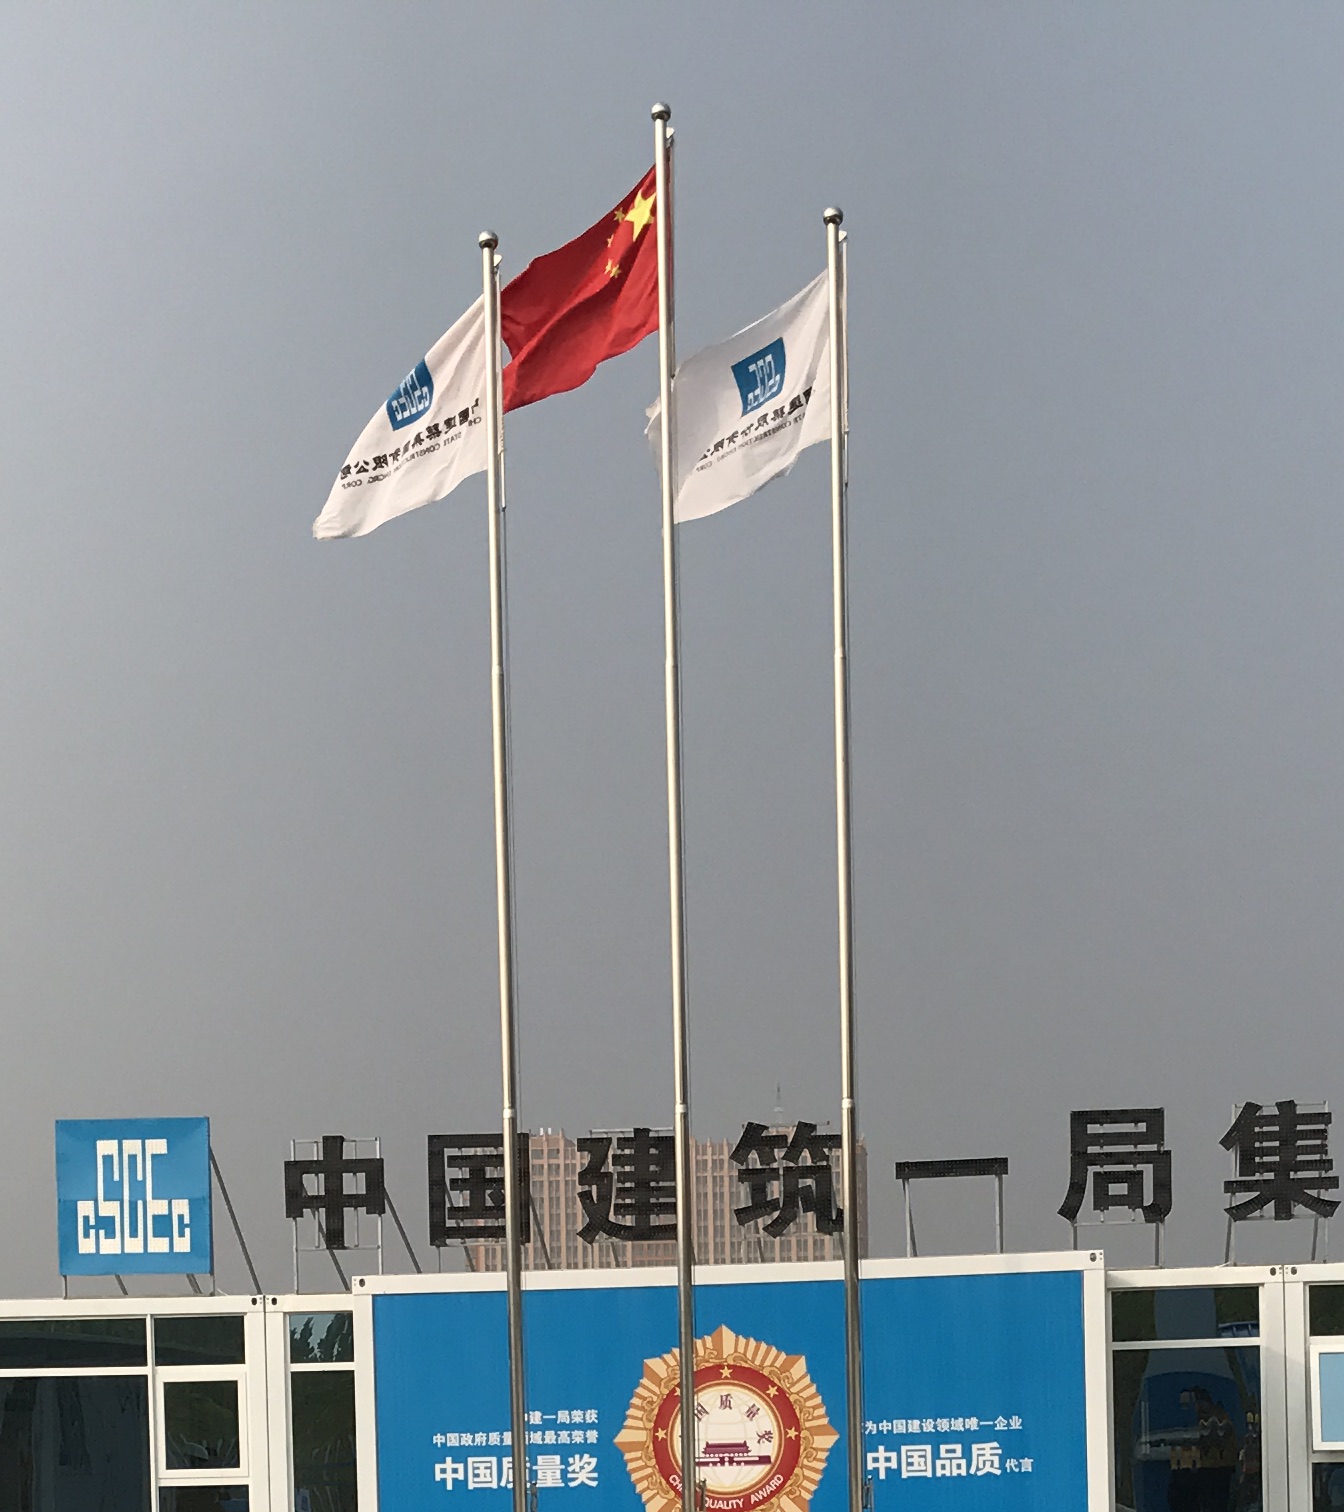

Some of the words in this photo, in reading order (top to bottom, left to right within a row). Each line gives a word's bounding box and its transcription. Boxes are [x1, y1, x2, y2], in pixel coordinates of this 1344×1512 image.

[524, 1409, 599, 1425] 建一局荣获
[861, 1415, 1024, 1435] 为中国建设领域唯一企业
[432, 1429, 599, 1448] 中国政府质量域最高荣誉
[750, 1473, 785, 1505] AWARD
